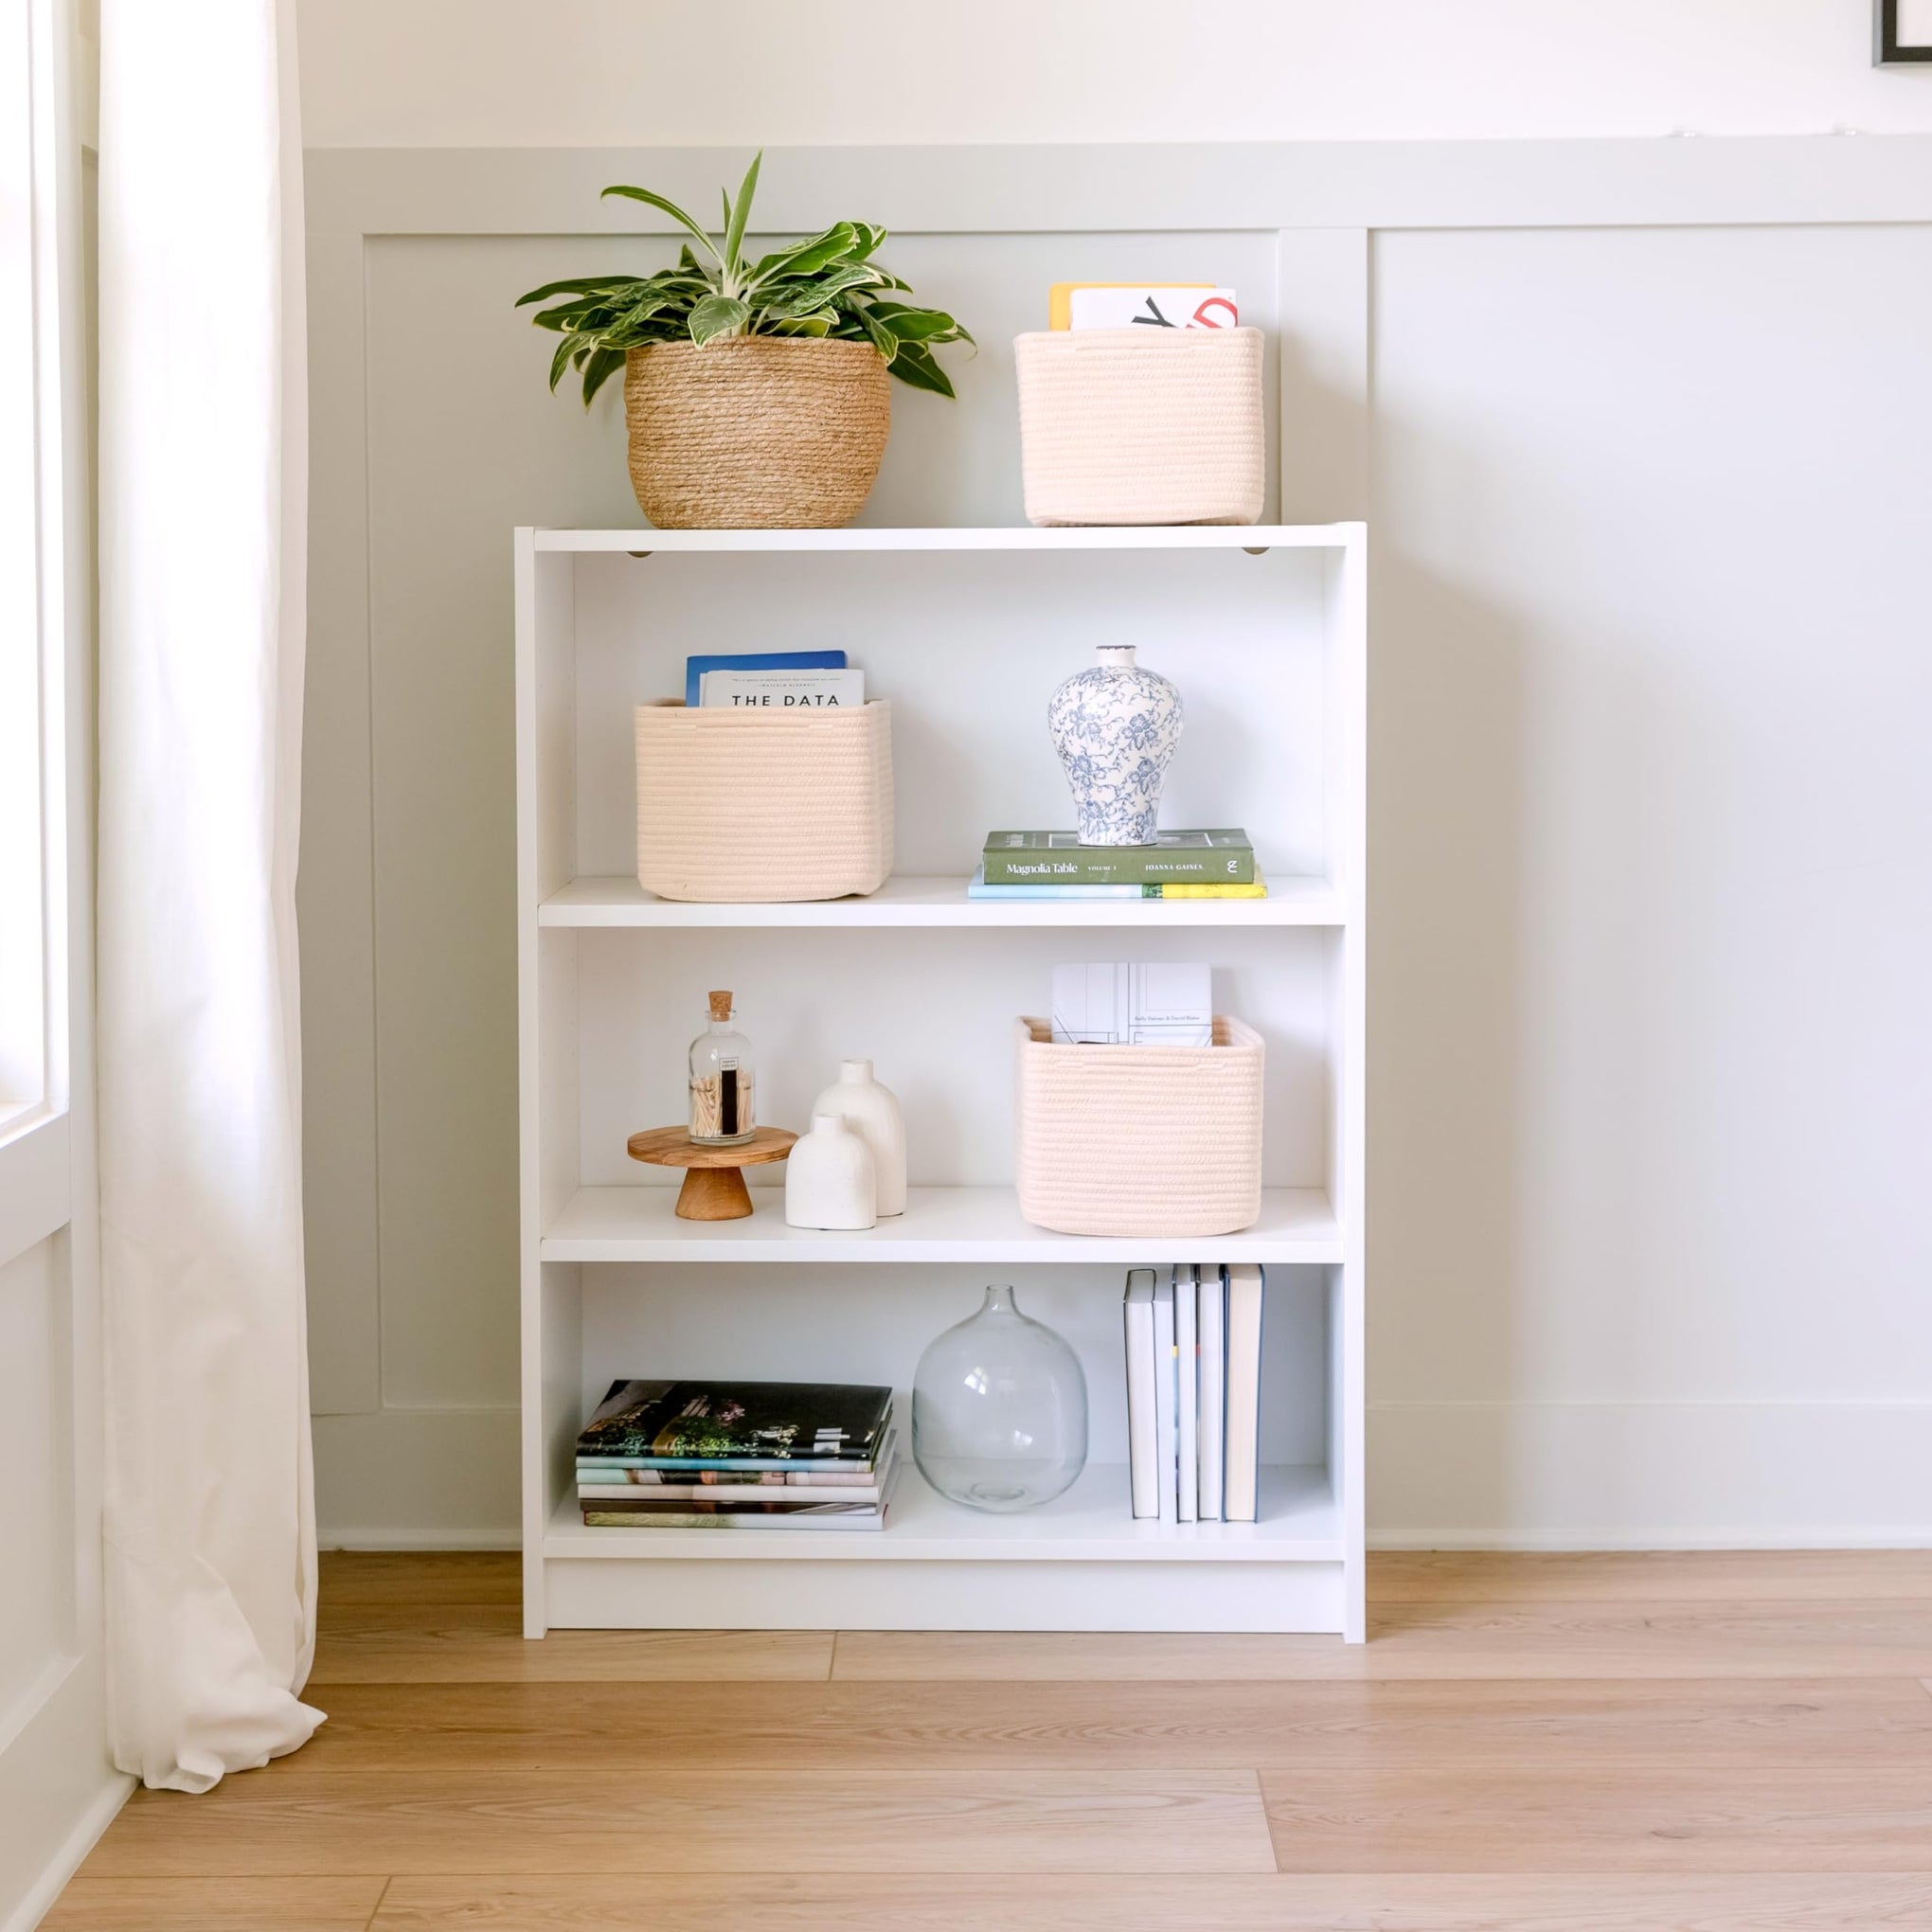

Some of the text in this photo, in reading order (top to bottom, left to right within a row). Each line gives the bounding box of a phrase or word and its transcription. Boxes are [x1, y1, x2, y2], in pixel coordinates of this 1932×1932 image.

[732, 694, 839, 707] THE DATA
[1006, 863, 1051, 876] Magnolia
[1052, 863, 1079, 873] Table
[1145, 864, 1174, 872] JOANNA
